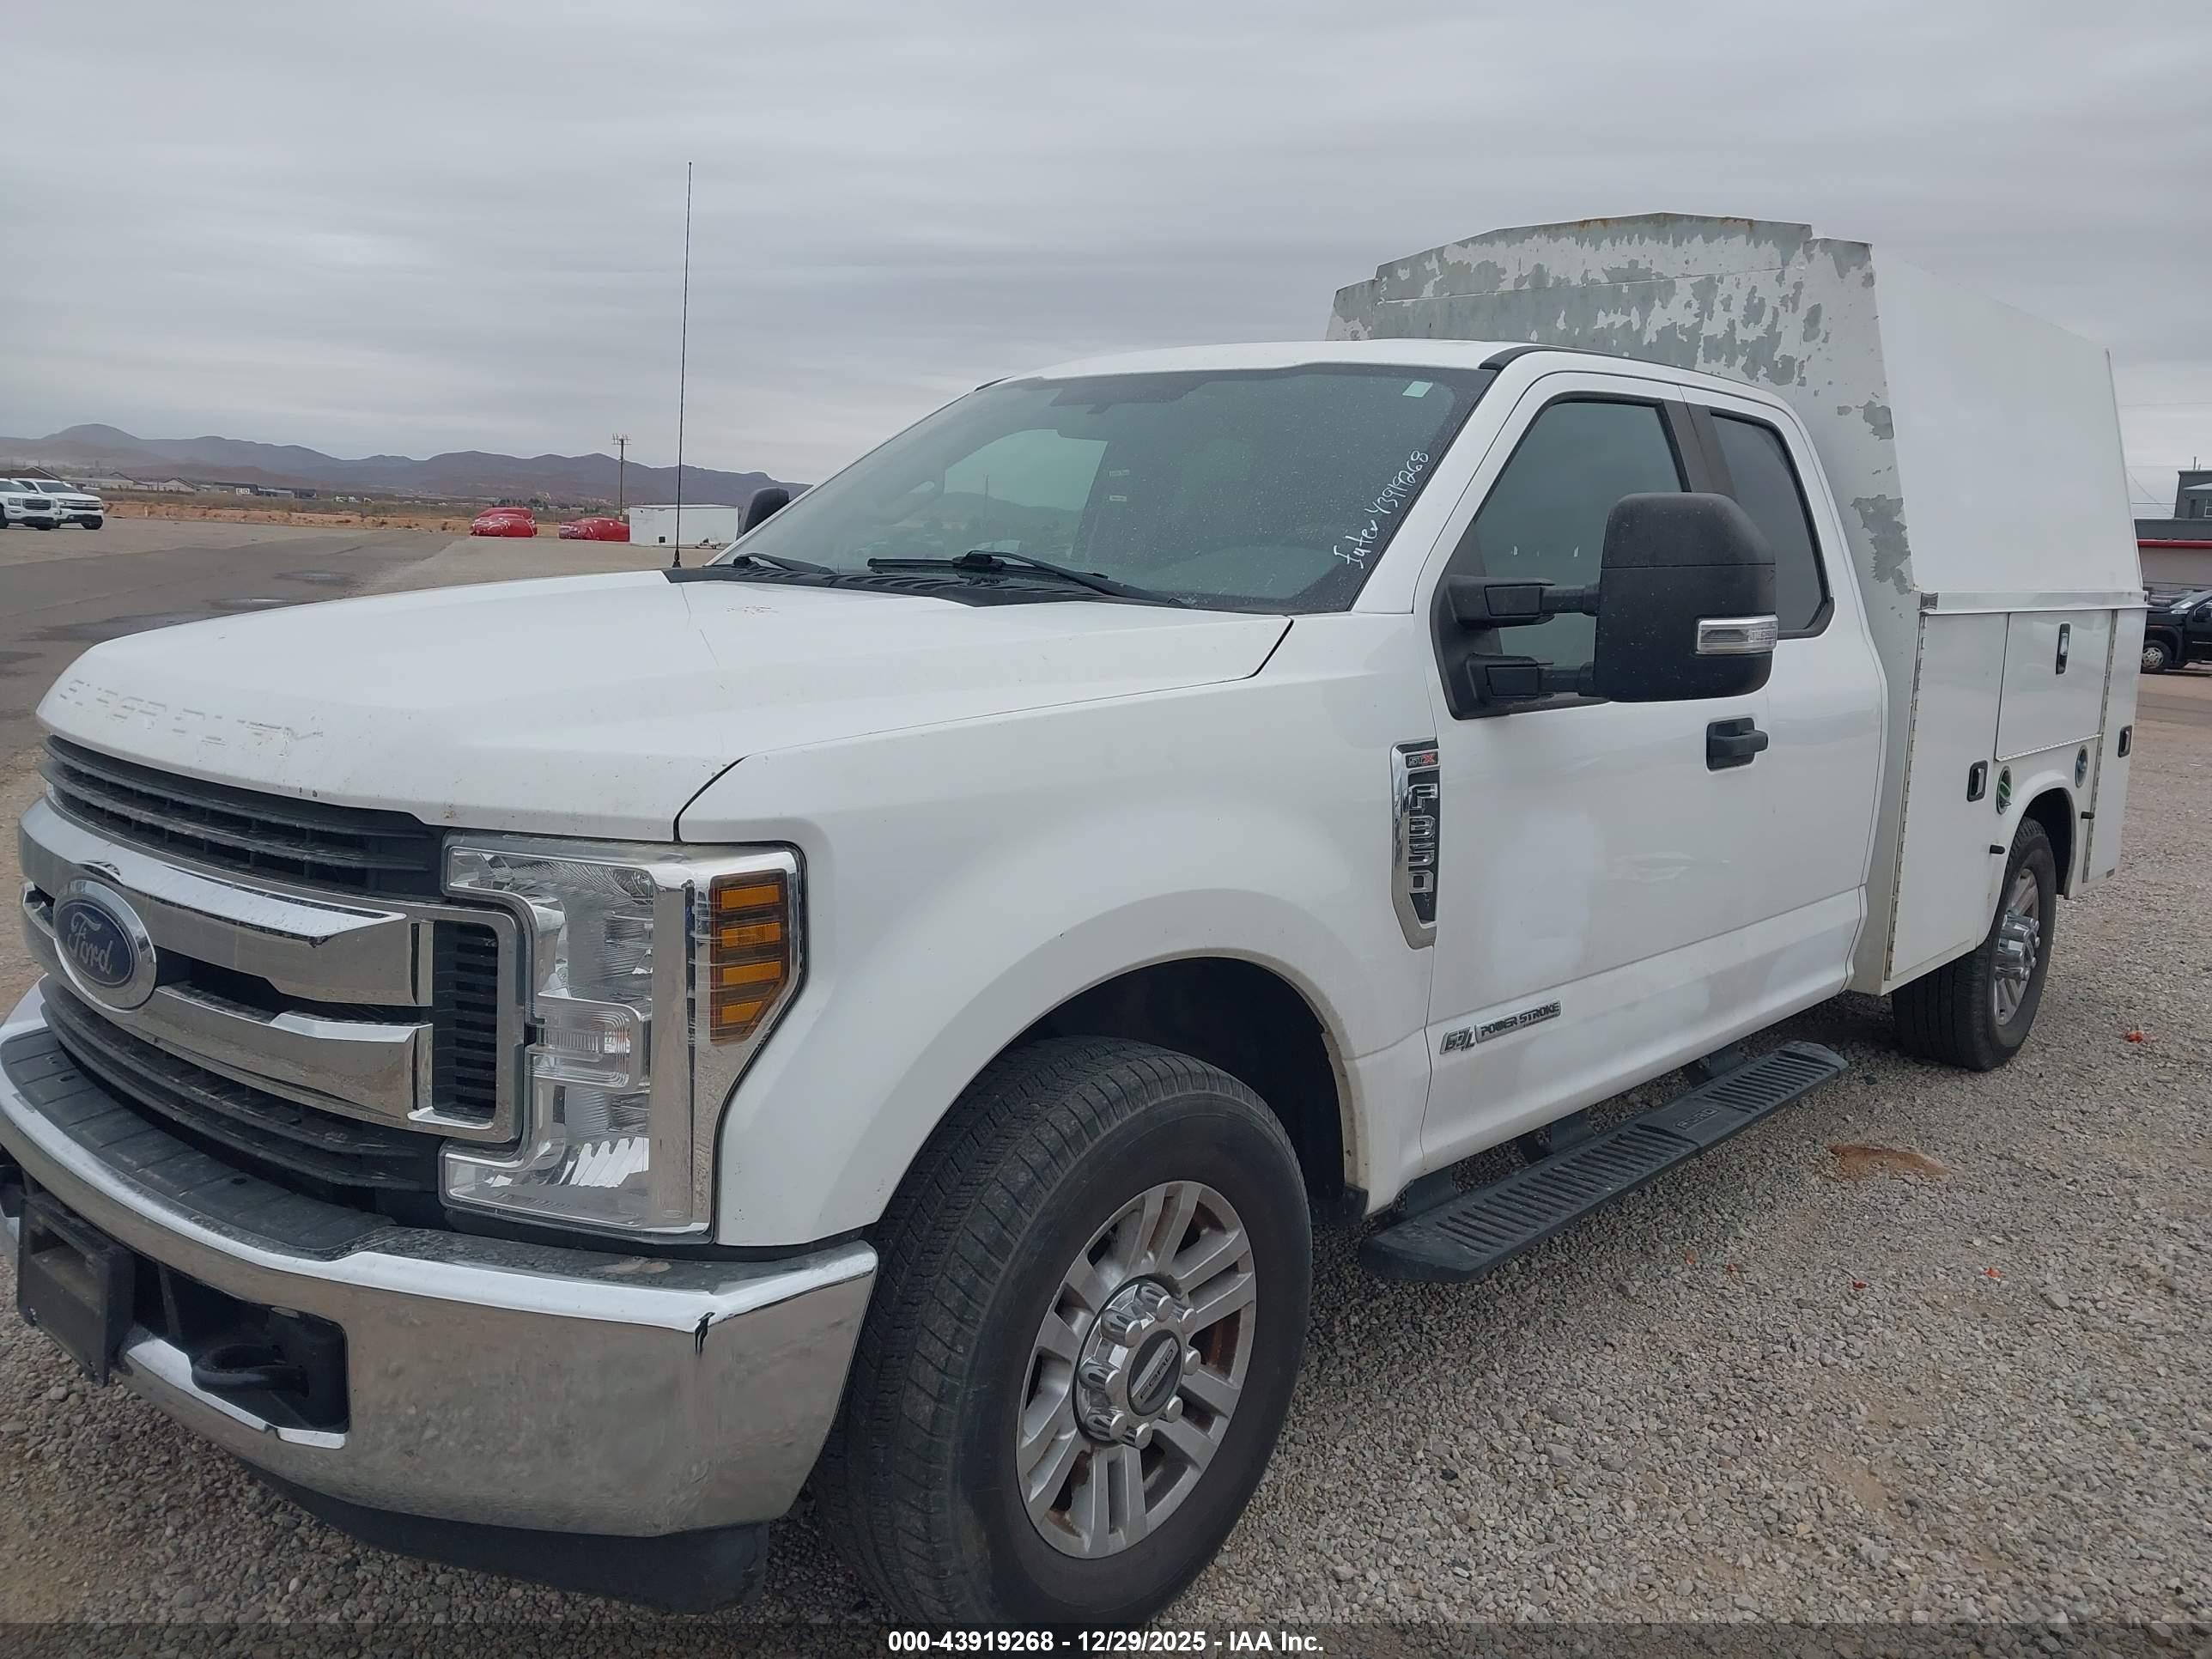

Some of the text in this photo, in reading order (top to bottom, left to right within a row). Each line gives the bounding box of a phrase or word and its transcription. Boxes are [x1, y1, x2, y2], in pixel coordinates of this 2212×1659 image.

[1364, 450, 1430, 514] 43919268
[1408, 753, 1436, 767] STX
[67, 911, 114, 975] Ford
[1481, 1016, 1518, 1037] POWER
[1519, 1001, 1560, 1025] STROKE
[1139, 1348, 1174, 1400] FORD
